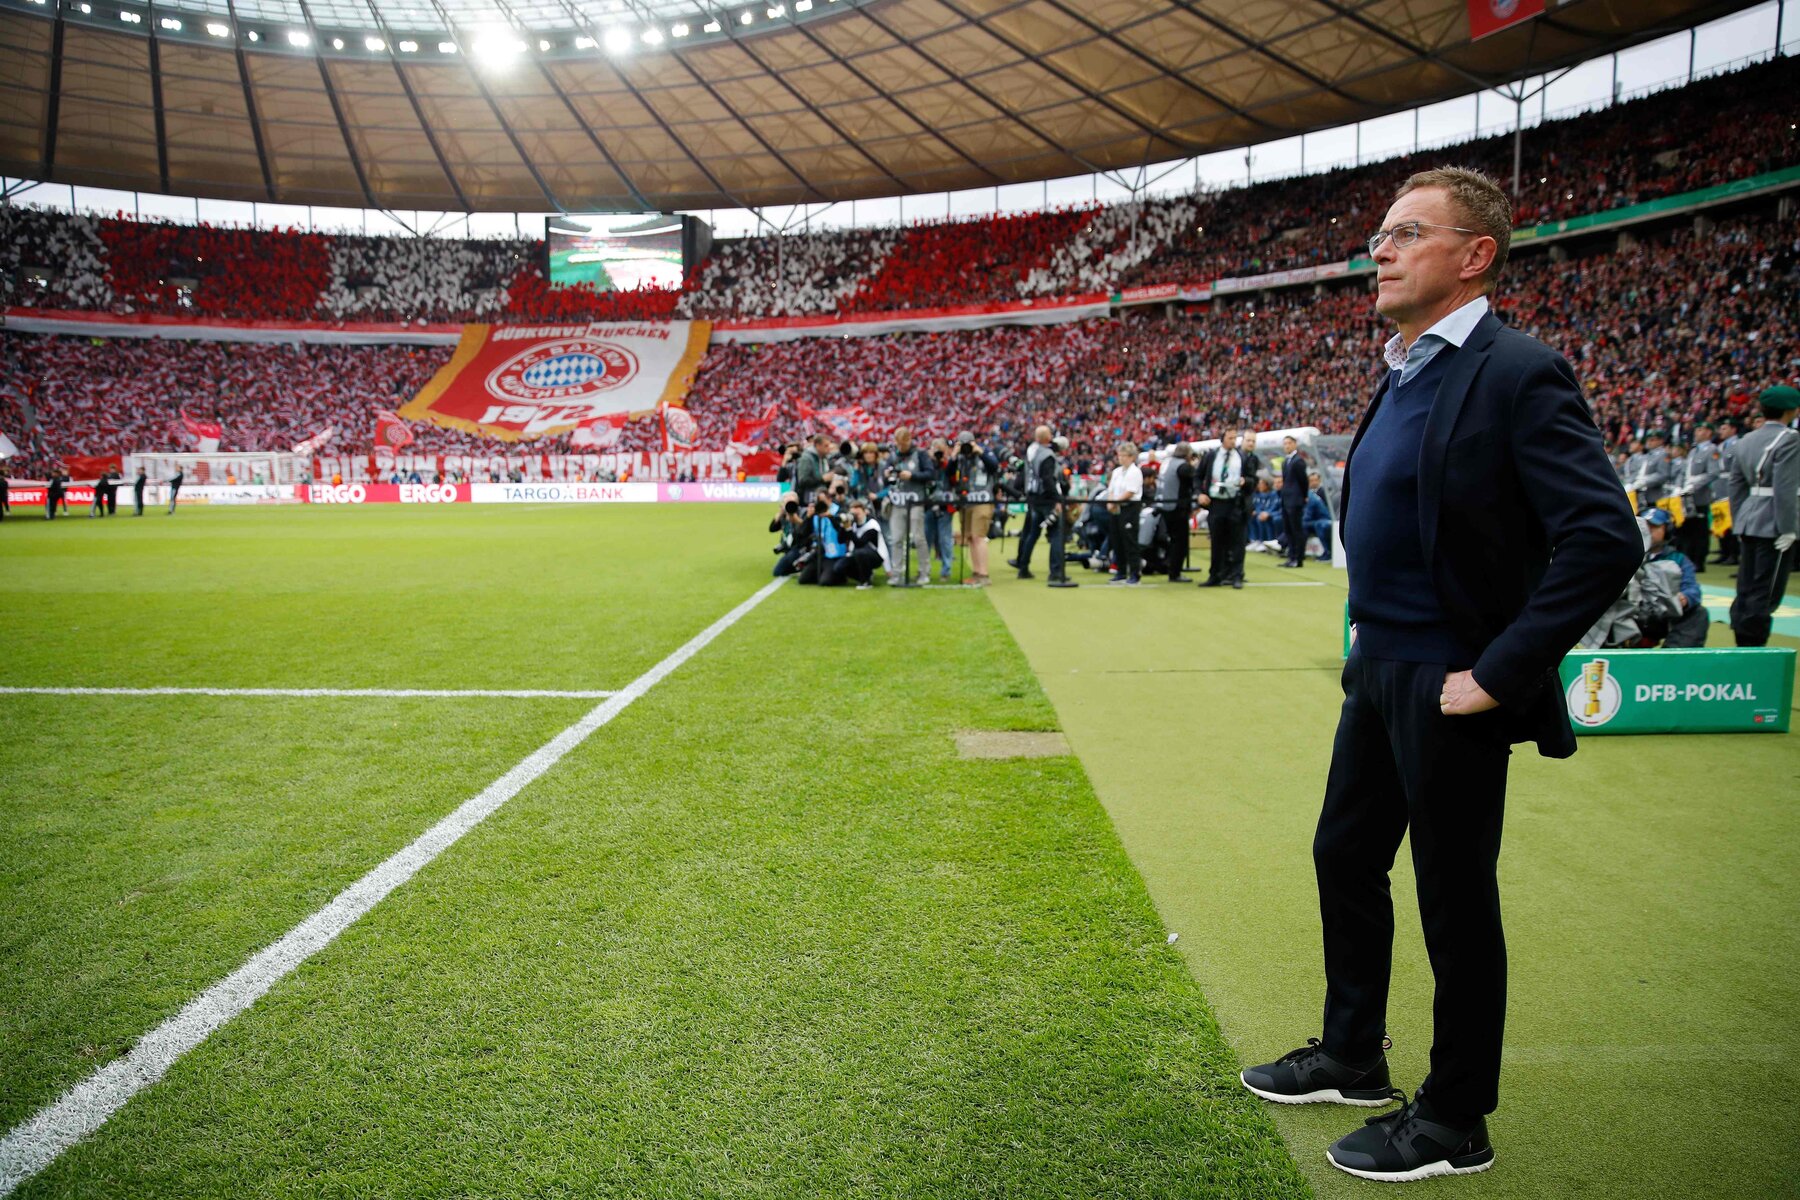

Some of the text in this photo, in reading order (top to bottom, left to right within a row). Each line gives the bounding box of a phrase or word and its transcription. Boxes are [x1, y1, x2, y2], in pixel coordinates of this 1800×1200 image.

[550, 343, 625, 368] BAYERN
[320, 455, 370, 484] DIE
[308, 485, 366, 503] ERGO
[400, 485, 457, 503] ERGO
[1635, 683, 1757, 702] DFB-POKAL
